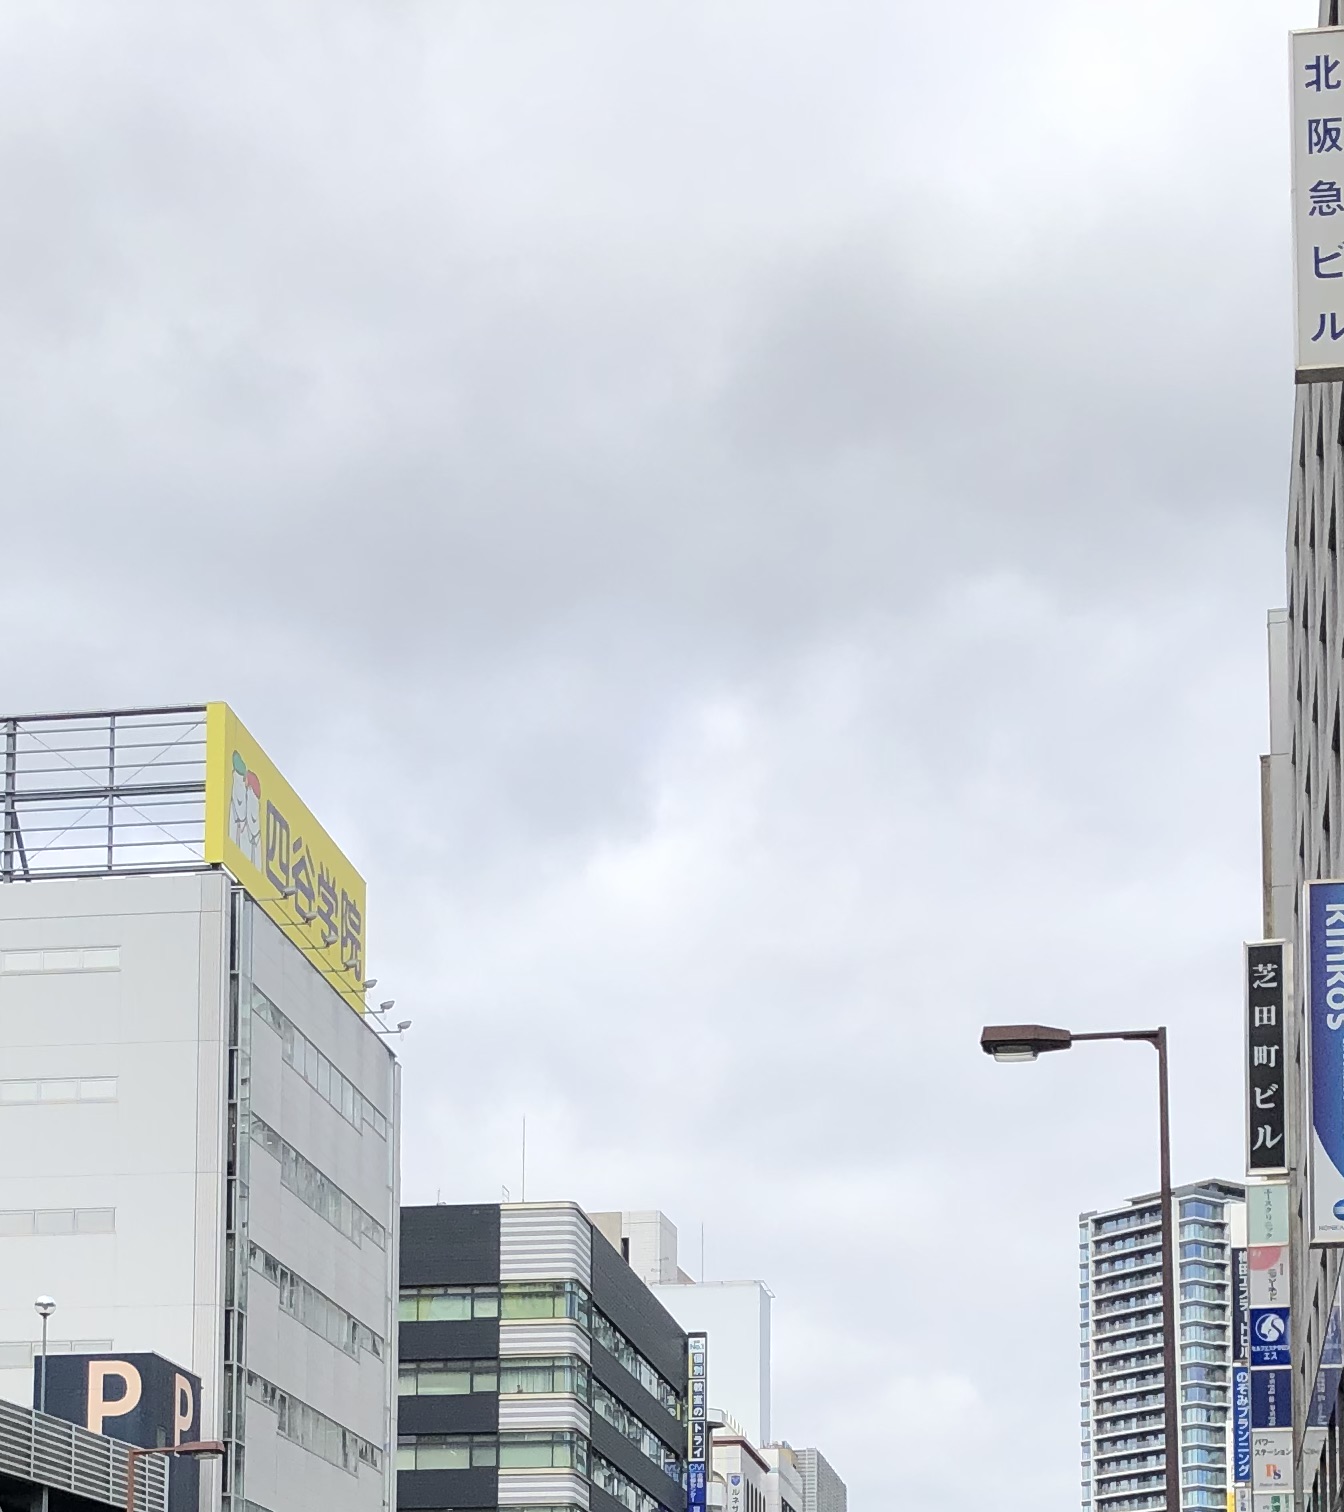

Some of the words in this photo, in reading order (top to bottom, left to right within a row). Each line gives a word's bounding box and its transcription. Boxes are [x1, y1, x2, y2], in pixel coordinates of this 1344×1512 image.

[265, 798, 364, 983] 四谷学院
[1251, 963, 1284, 1151] 芝田町ビル
[1263, 1352, 1278, 1360] エス
[87, 1360, 143, 1435] P
[174, 1372, 194, 1448] P
[1254, 1447, 1292, 1456] ステーション
